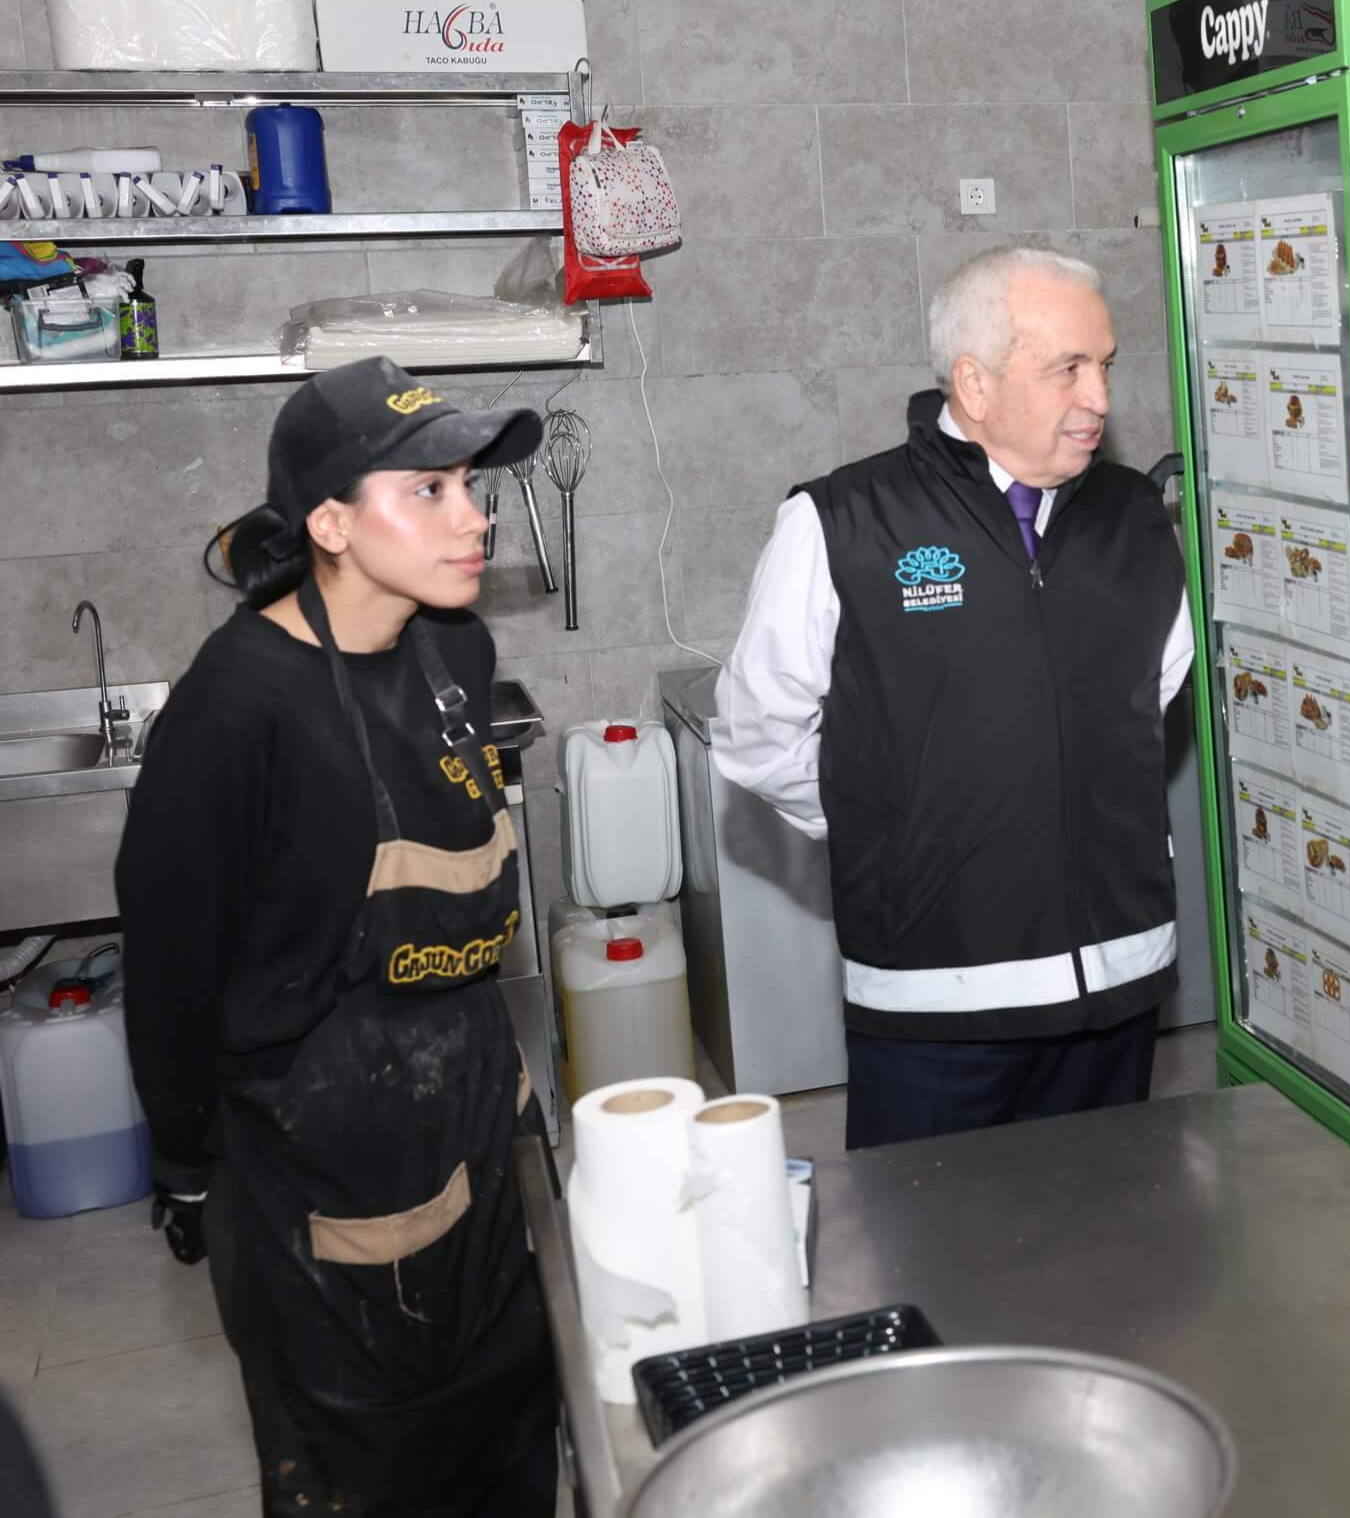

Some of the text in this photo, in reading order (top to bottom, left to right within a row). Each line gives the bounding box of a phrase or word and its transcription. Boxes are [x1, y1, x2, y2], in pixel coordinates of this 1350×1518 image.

[1201, 0, 1269, 65] Cappy
[426, 55, 487, 65] TACO KABUĞU
